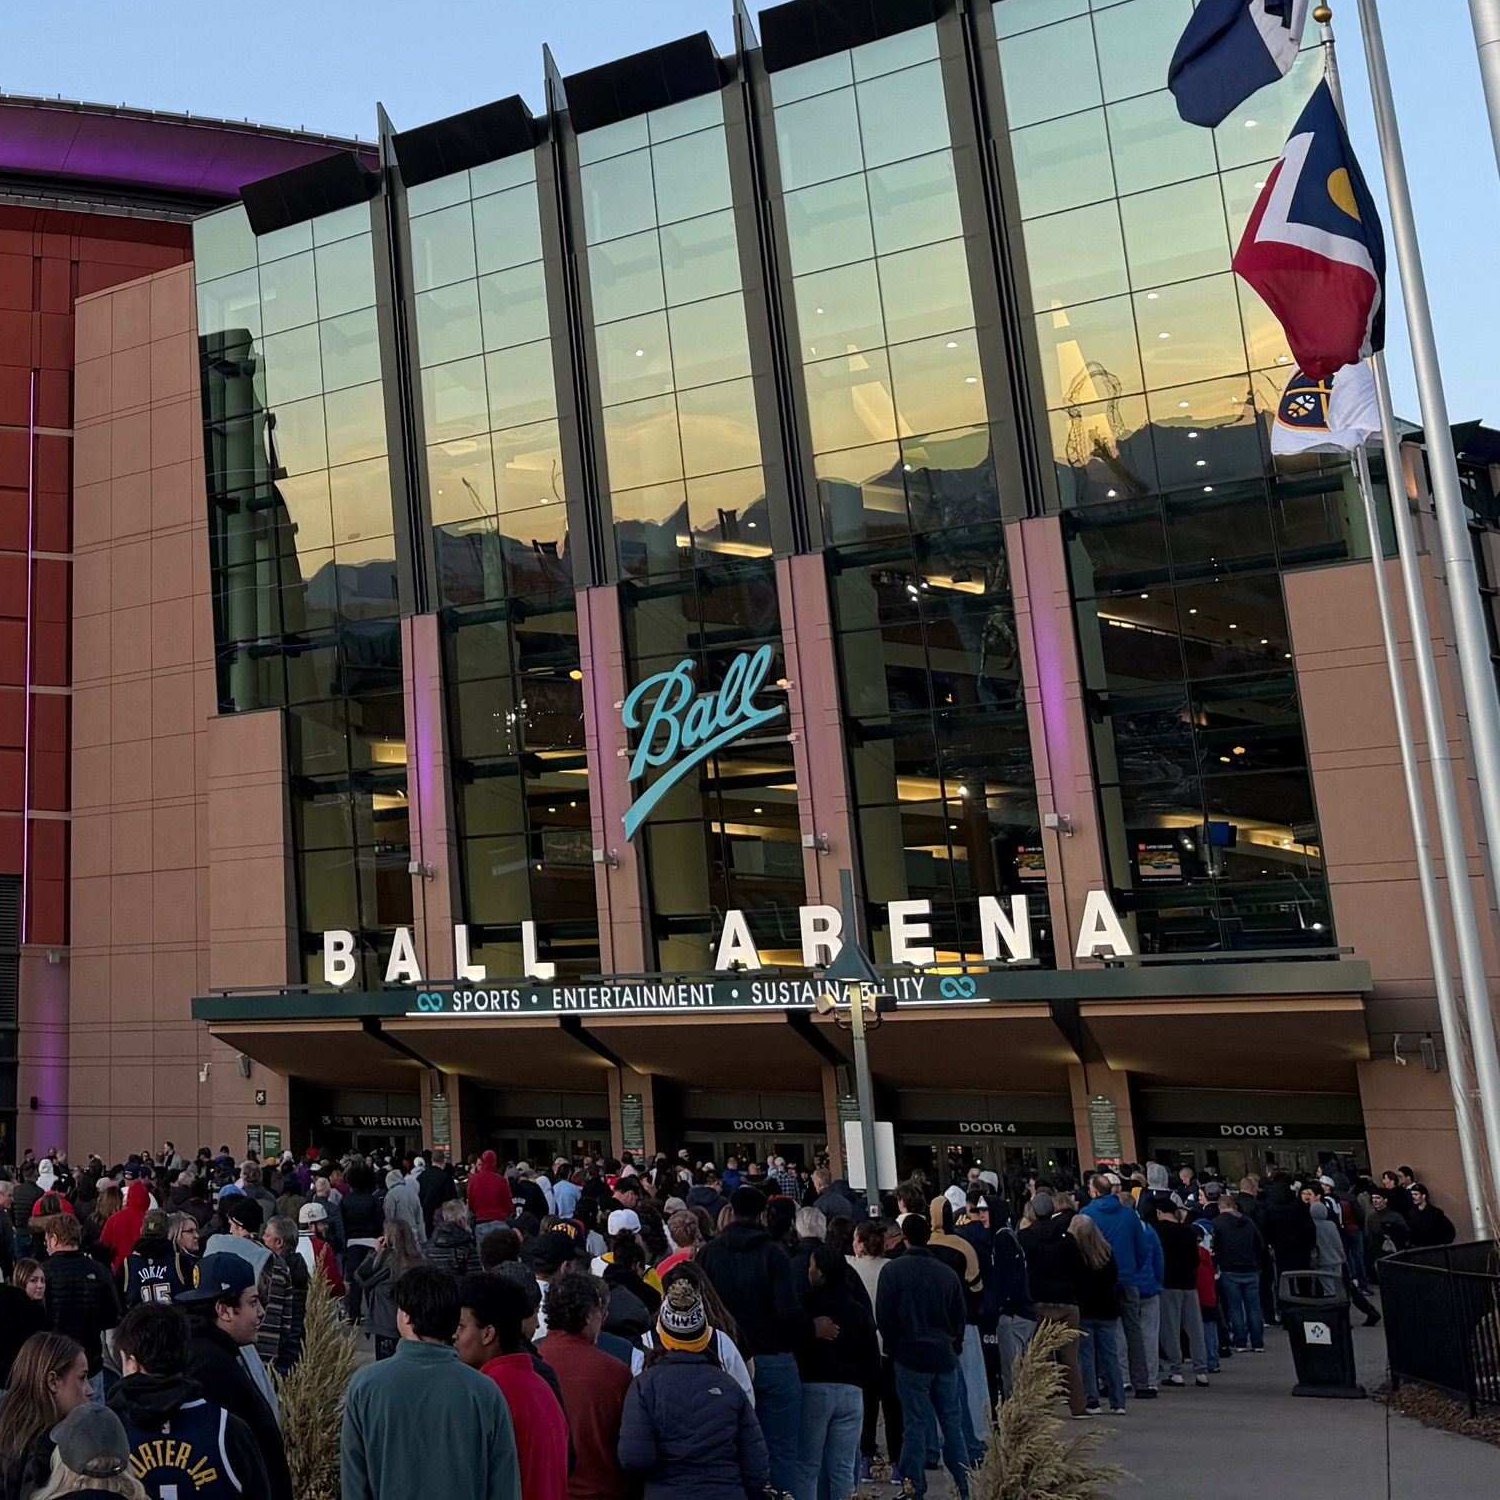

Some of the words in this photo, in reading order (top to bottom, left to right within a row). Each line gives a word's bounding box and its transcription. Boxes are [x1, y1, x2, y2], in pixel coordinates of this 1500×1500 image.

[622, 644, 785, 842] Ball
[324, 921, 555, 986] BALL
[715, 890, 1133, 971] ARENA
[453, 990, 520, 1011] SPORTS
[553, 984, 714, 1008] ENTERTAINMENT
[359, 1116, 378, 1126] VIP
[380, 1116, 422, 1127] ENTRA
[536, 1118, 572, 1129] DOOR
[575, 1119, 584, 1129] 2
[733, 1120, 773, 1131] DOOR
[776, 1121, 785, 1131] 3
[959, 1122, 1003, 1133] DOOR
[1007, 1123, 1016, 1134] 4
[1220, 1125, 1269, 1136] DOOR
[1274, 1126, 1283, 1136] 5
[140, 1282, 173, 1304] 15
[662, 1305, 703, 1327] ENVER
[129, 1439, 193, 1479] ORTER
[187, 1455, 218, 1491] JR.
